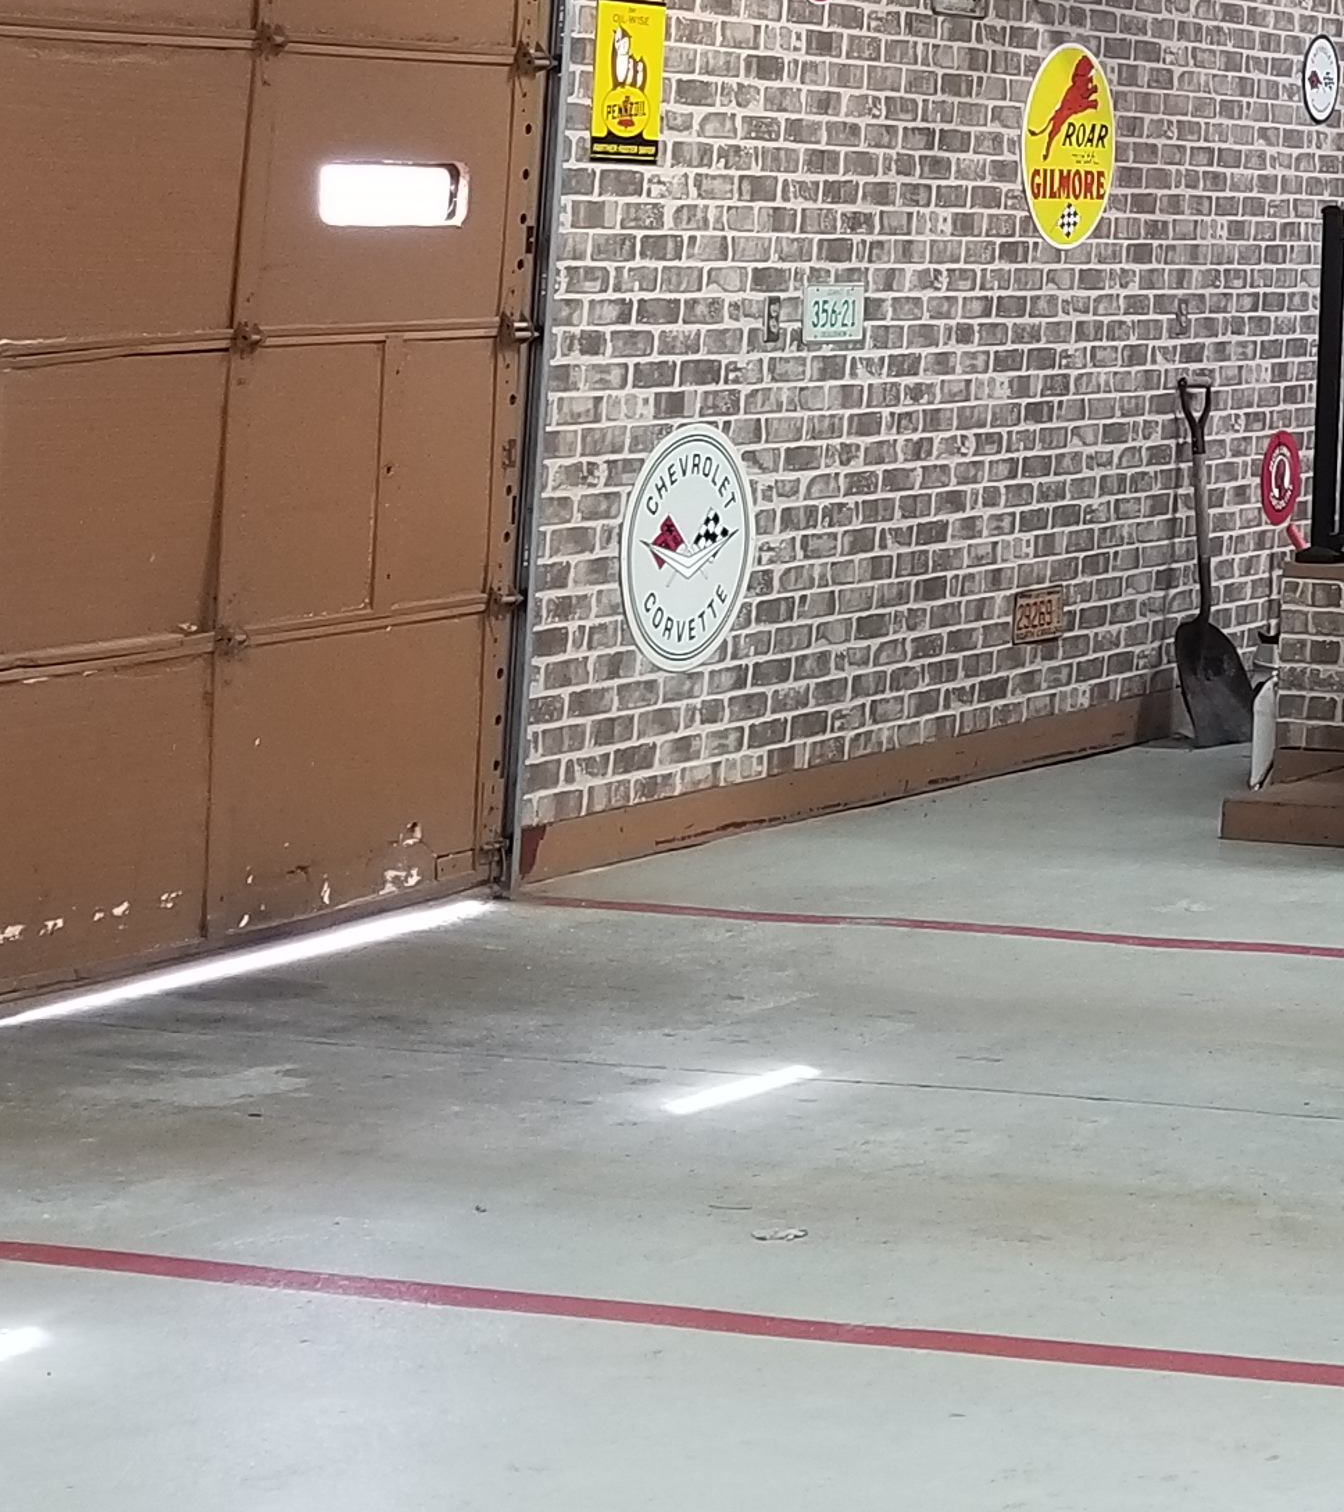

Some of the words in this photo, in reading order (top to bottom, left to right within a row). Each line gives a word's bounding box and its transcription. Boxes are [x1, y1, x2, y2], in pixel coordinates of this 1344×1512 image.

[1062, 122, 1109, 148] ROAR
[1031, 168, 1106, 201] GILMORE
[646, 453, 737, 516] CHEVROLET
[644, 584, 729, 643] CORVETTE
